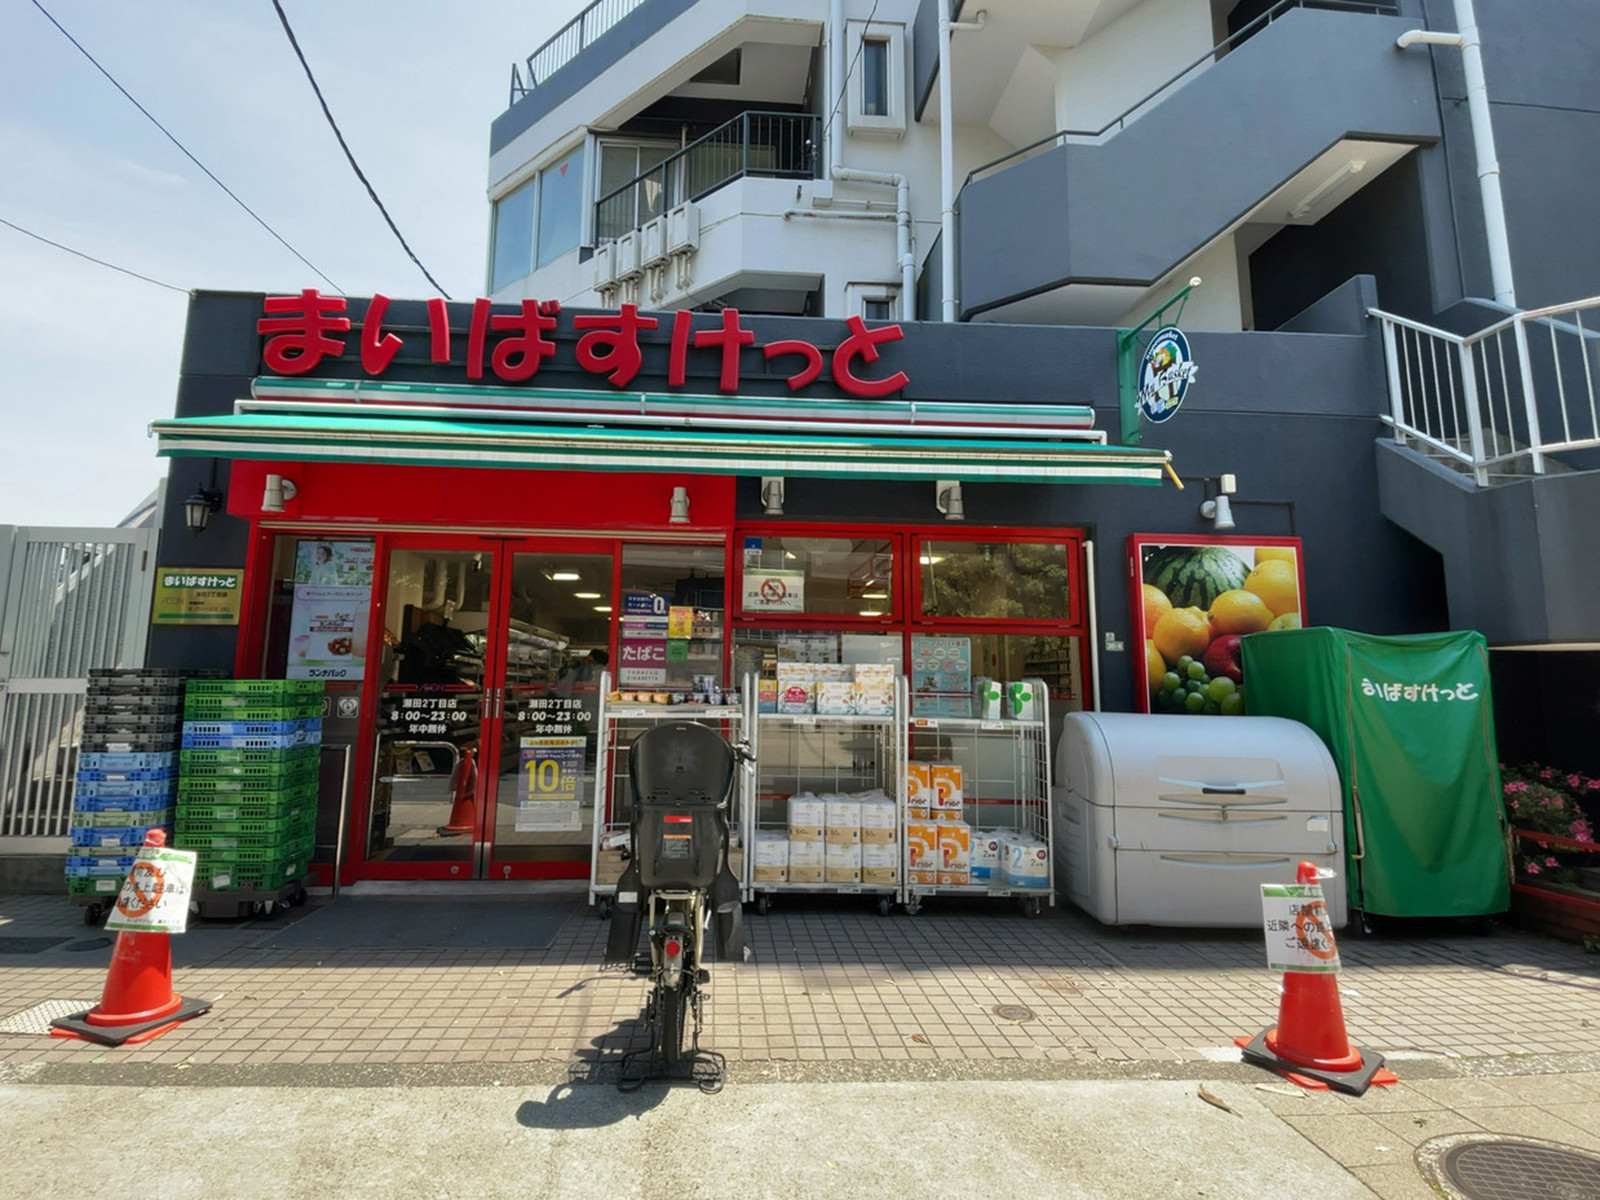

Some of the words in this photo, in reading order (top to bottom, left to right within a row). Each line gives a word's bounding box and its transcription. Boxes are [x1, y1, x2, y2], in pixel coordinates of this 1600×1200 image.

[257, 288, 910, 397] まいばすけっと
[164, 576, 236, 587] まいばすけっと
[622, 645, 665, 661] たばこ
[308, 669, 347, 677] ランチパック
[408, 724, 447, 734] 年中無休
[535, 724, 573, 734] 年中無休
